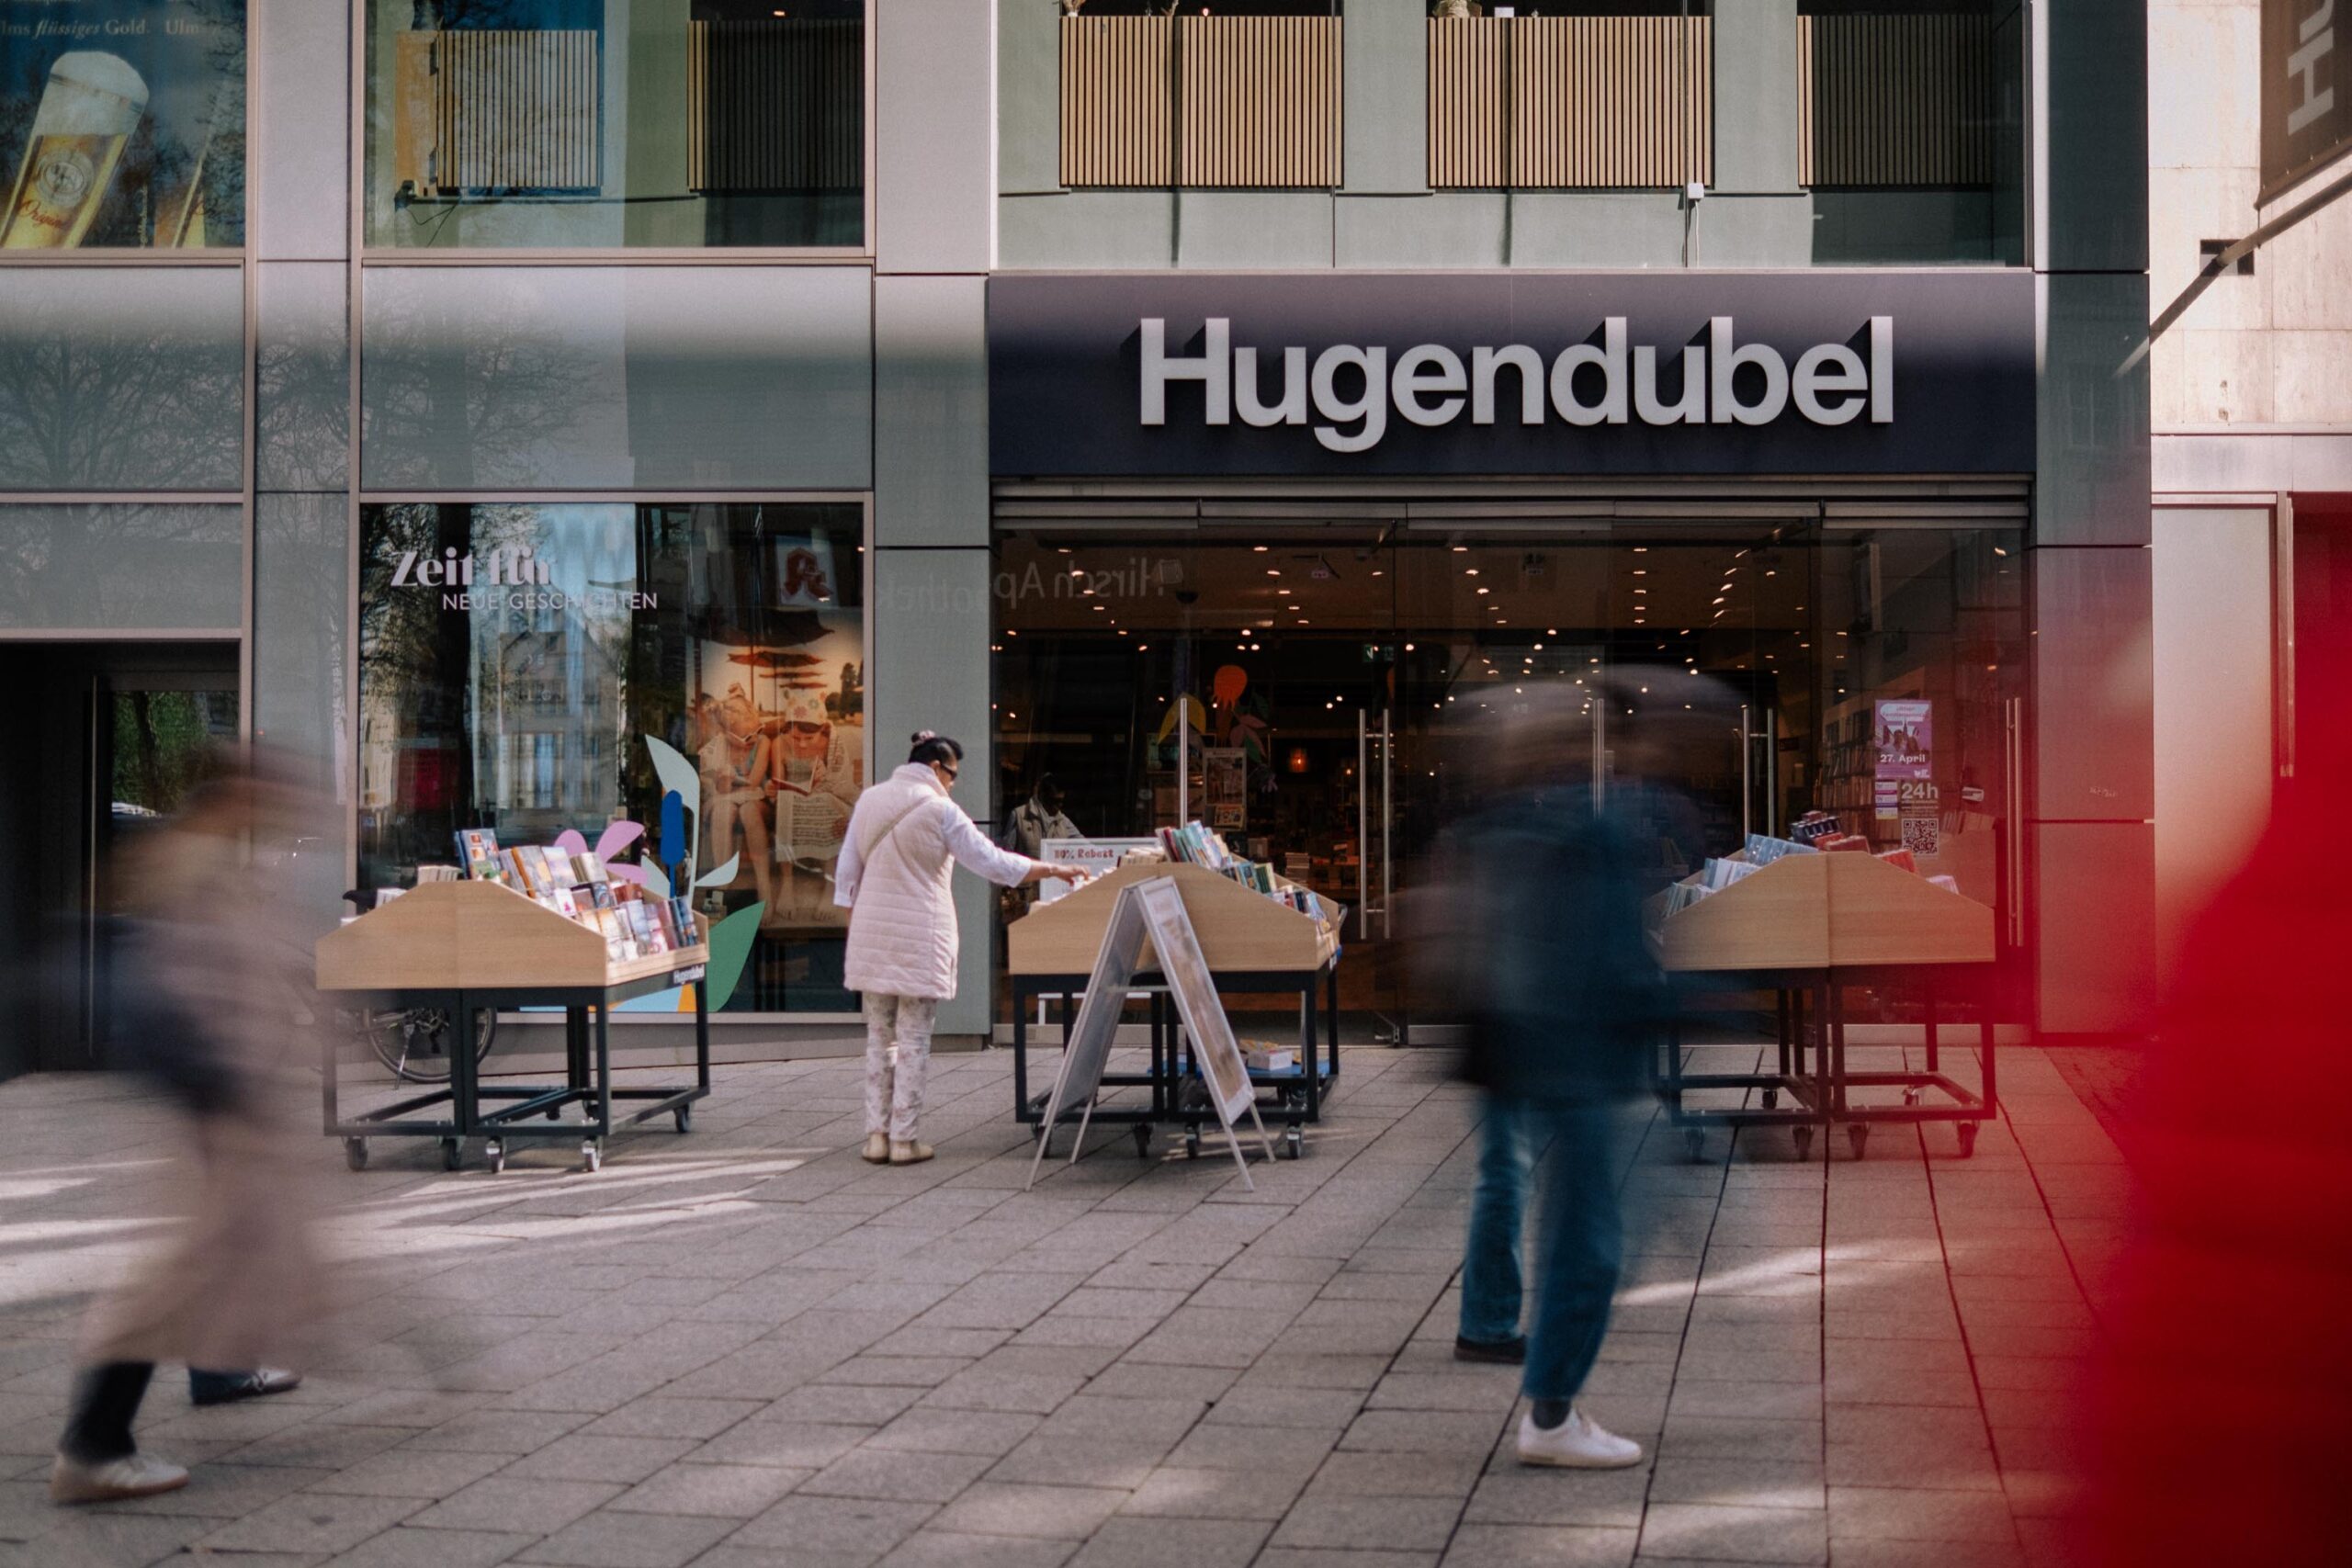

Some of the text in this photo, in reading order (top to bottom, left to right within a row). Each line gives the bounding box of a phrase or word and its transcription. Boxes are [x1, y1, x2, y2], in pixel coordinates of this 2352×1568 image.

[0, 18, 151, 39] lms flüssiges Gold.
[1138, 315, 1894, 454] Hugendubel
[390, 547, 473, 588] Zeit
[442, 591, 659, 610] NEUE GESCHICHTEN
[1880, 753, 1926, 764] 27. April
[1901, 782, 1939, 799] 24h
[1078, 849, 1113, 858] Rabatt
